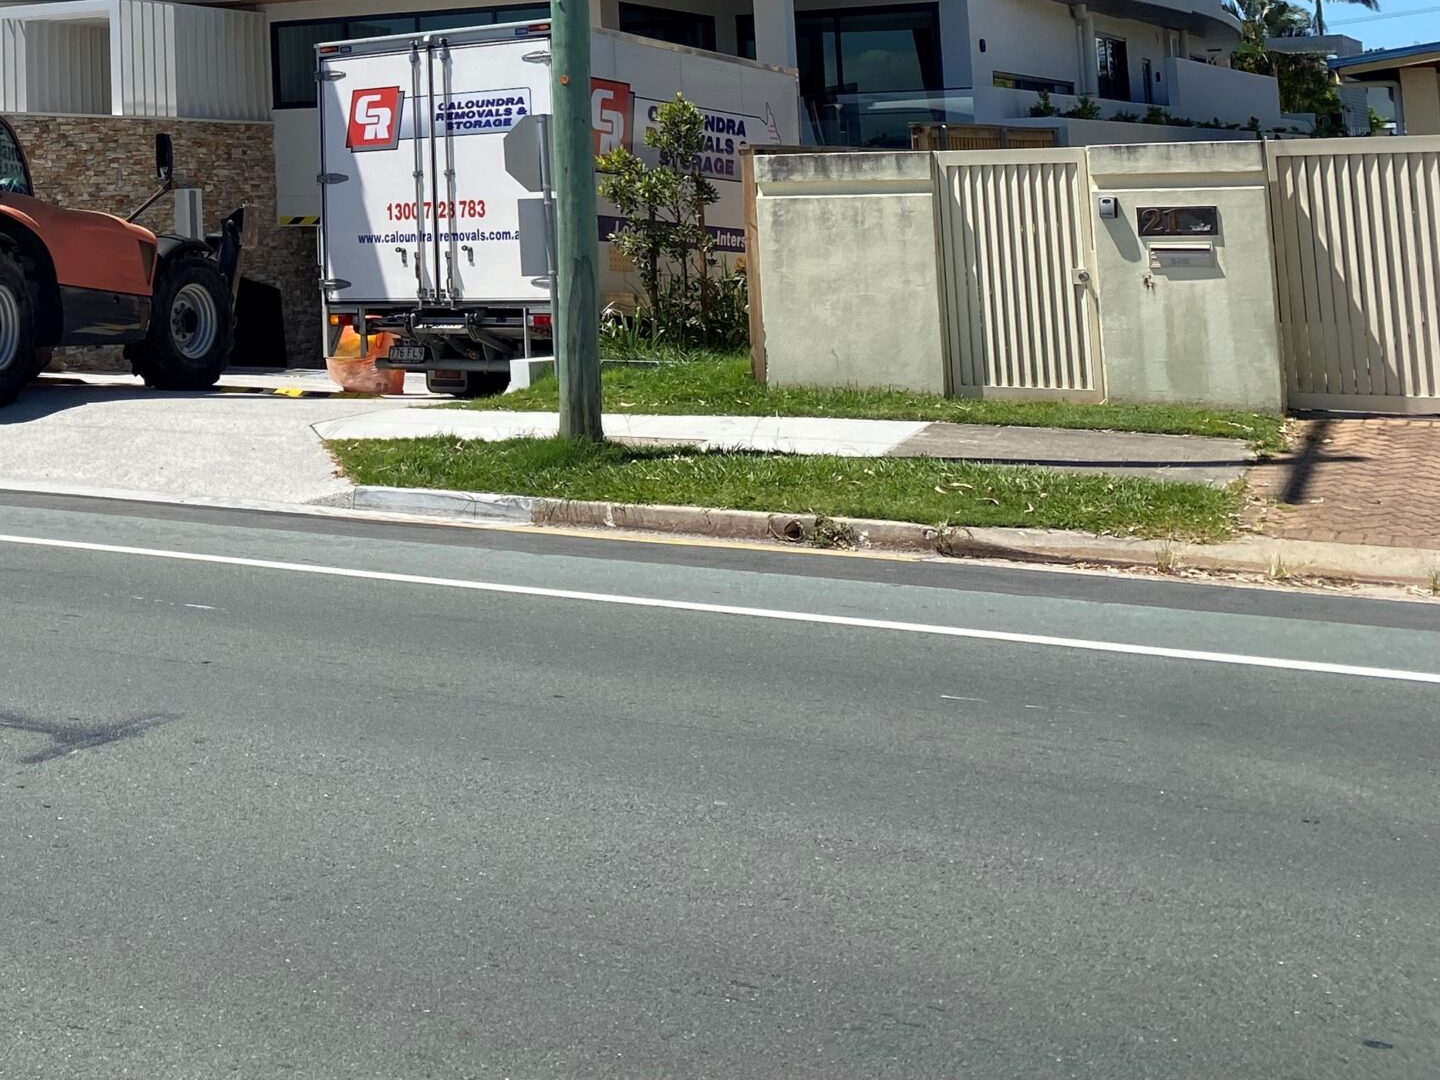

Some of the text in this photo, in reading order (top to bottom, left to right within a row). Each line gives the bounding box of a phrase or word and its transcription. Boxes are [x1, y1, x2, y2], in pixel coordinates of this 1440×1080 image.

[438, 97, 525, 111] CALOUNDRA
[436, 107, 527, 122] REMOVALS &
[446, 118, 513, 131] STORAGE
[386, 203, 419, 220] 1300
[459, 200, 486, 218] 783
[1141, 208, 1180, 233] 21
